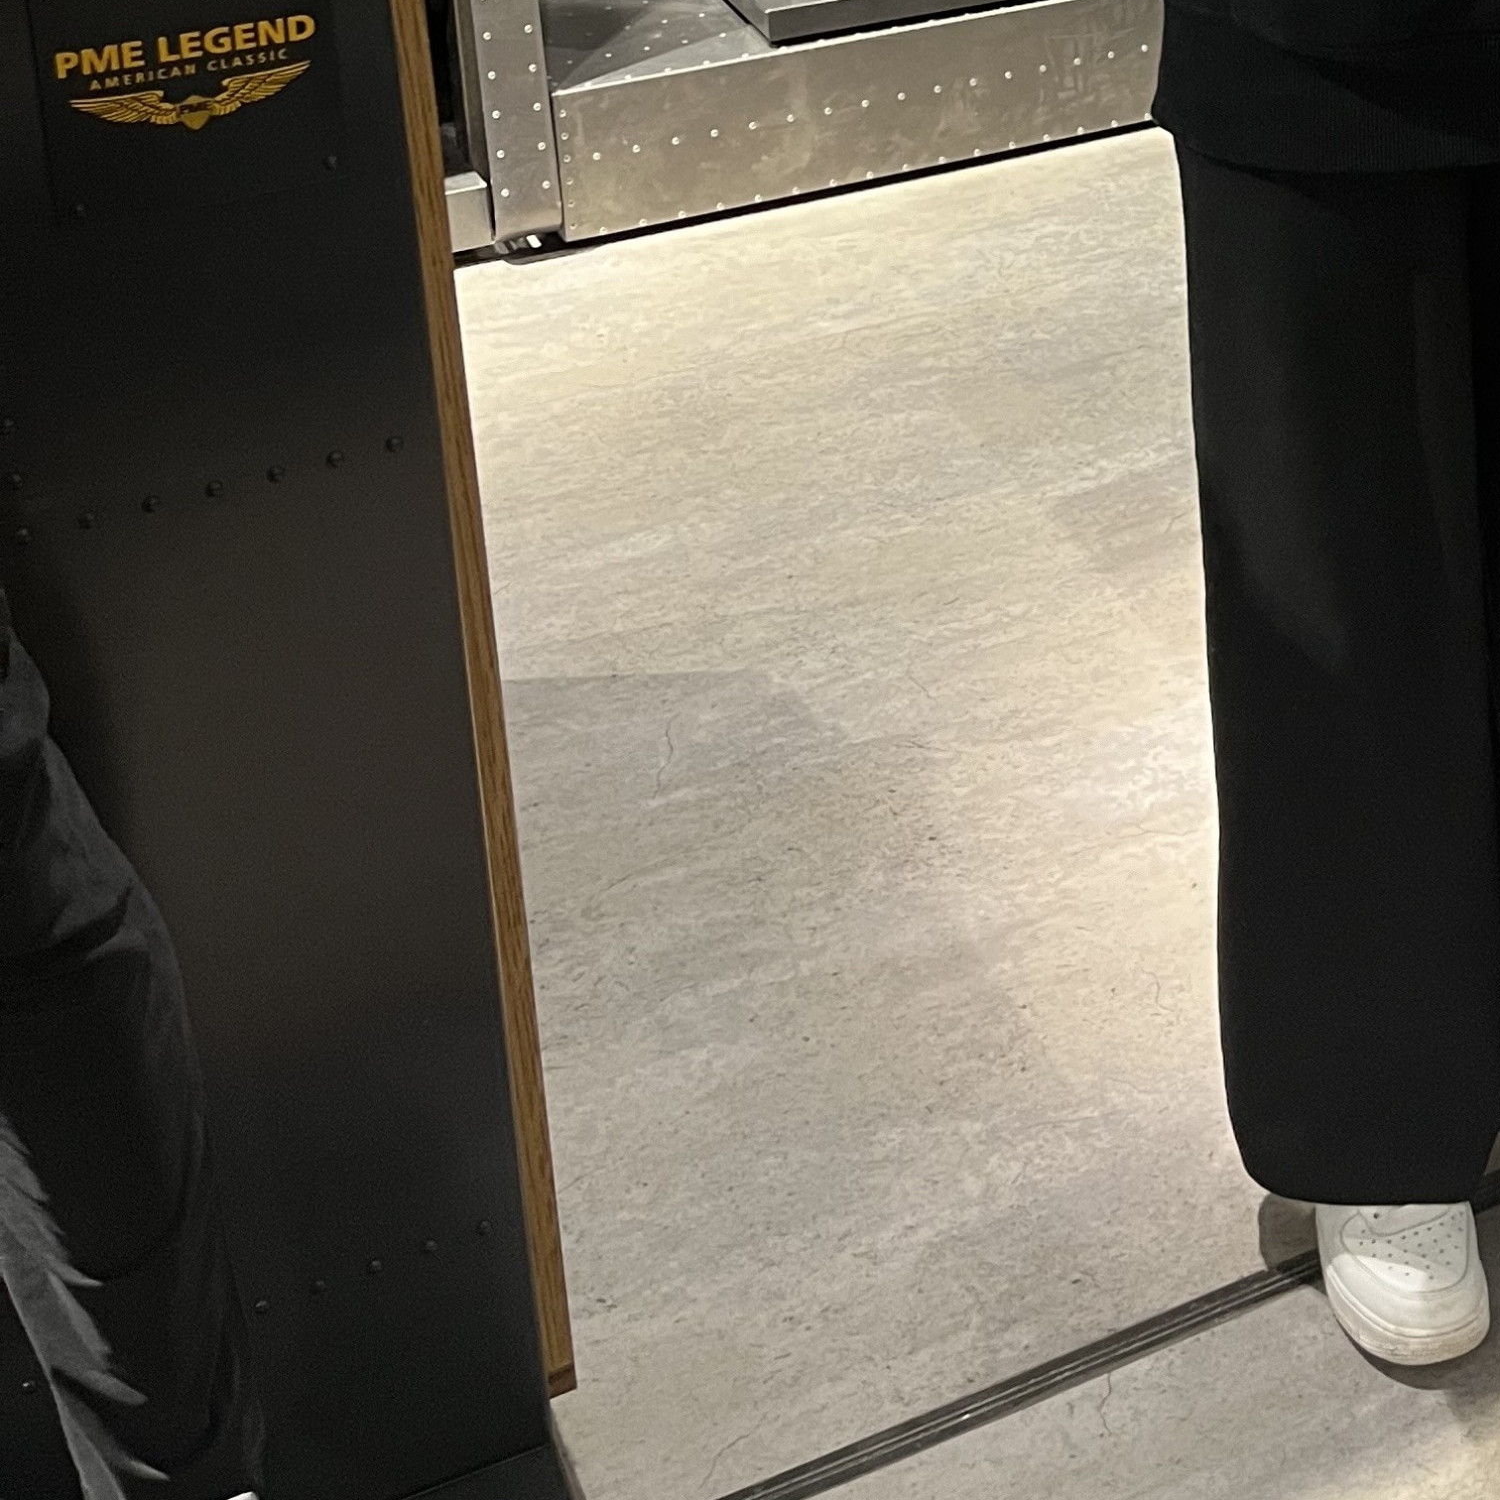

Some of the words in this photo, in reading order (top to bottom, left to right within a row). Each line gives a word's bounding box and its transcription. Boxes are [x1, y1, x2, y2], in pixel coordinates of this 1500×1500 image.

[55, 40, 146, 79] PME
[157, 14, 316, 63] LEGEND
[89, 64, 196, 91] AMERICAN
[206, 48, 289, 71] CLASSIC
